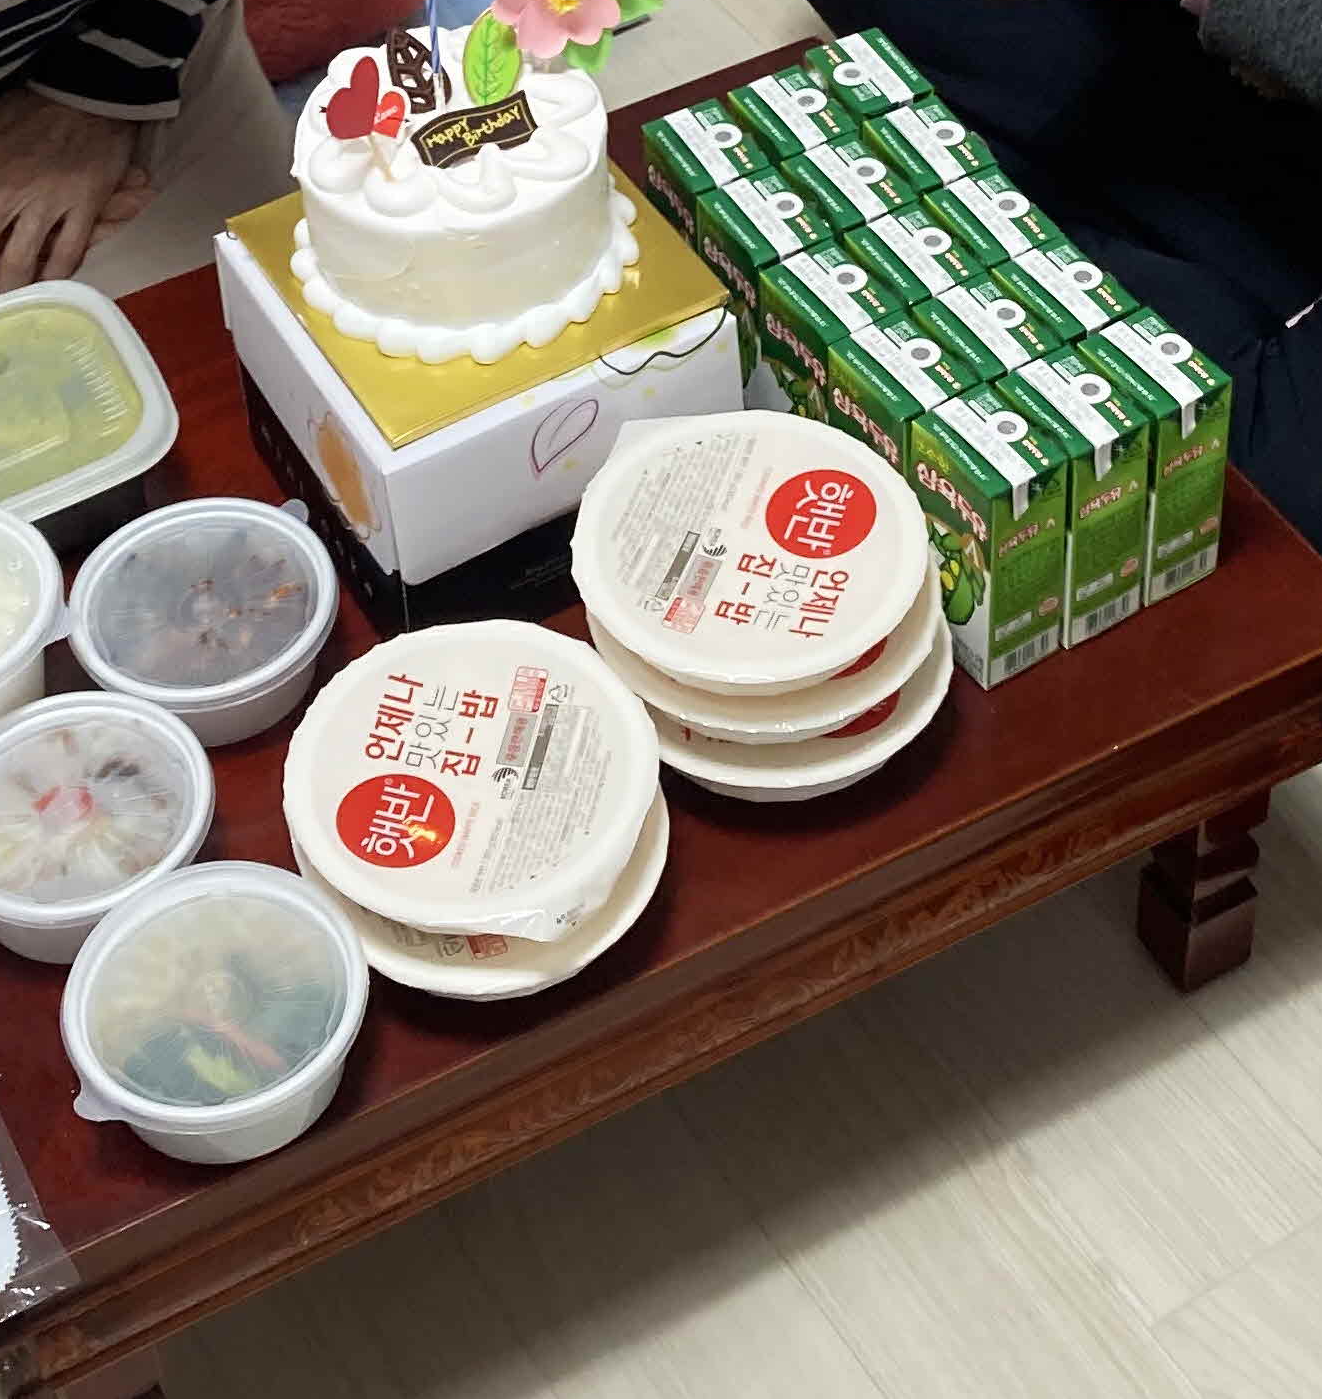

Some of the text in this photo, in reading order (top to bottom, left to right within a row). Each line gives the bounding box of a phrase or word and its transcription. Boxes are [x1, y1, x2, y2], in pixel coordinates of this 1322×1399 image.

[783, 479, 855, 555] 햇반
[753, 562, 812, 633] 맛있는
[788, 568, 850, 639] 언제나
[364, 672, 424, 762] 언제나
[404, 684, 460, 771] 맛있는
[360, 782, 435, 860] 햇반
